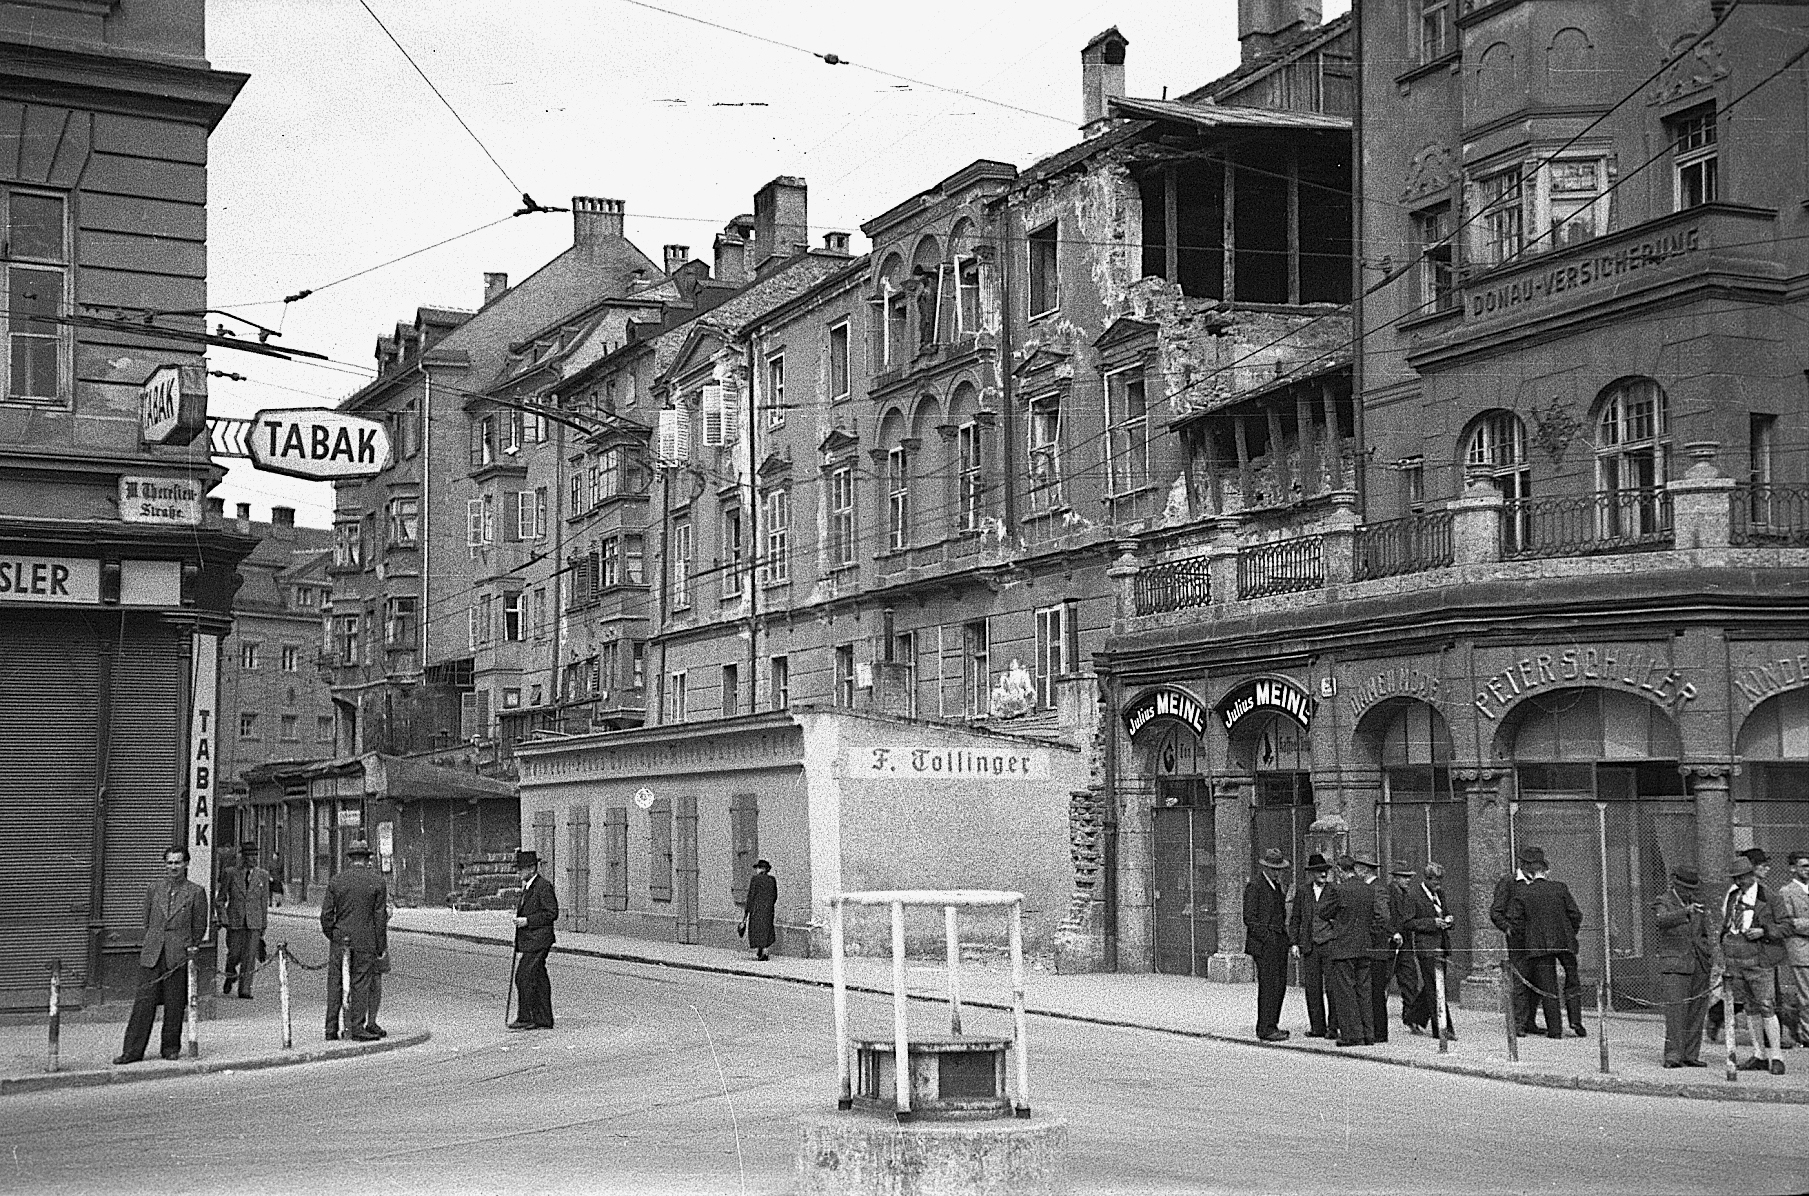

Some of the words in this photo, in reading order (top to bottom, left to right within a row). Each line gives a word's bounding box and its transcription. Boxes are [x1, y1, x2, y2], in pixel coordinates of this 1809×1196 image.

[1473, 228, 1699, 316] DONAU-VERSICHERUNG
[263, 420, 378, 464] TABAK
[0, 562, 69, 595] SLER
[1129, 705, 1155, 735] Julius
[1157, 693, 1204, 732] MEINL
[1225, 697, 1254, 728] Julius
[1256, 681, 1311, 725] MEINL
[195, 709, 210, 846] TABAK
[911, 748, 1031, 776] Tollinger
